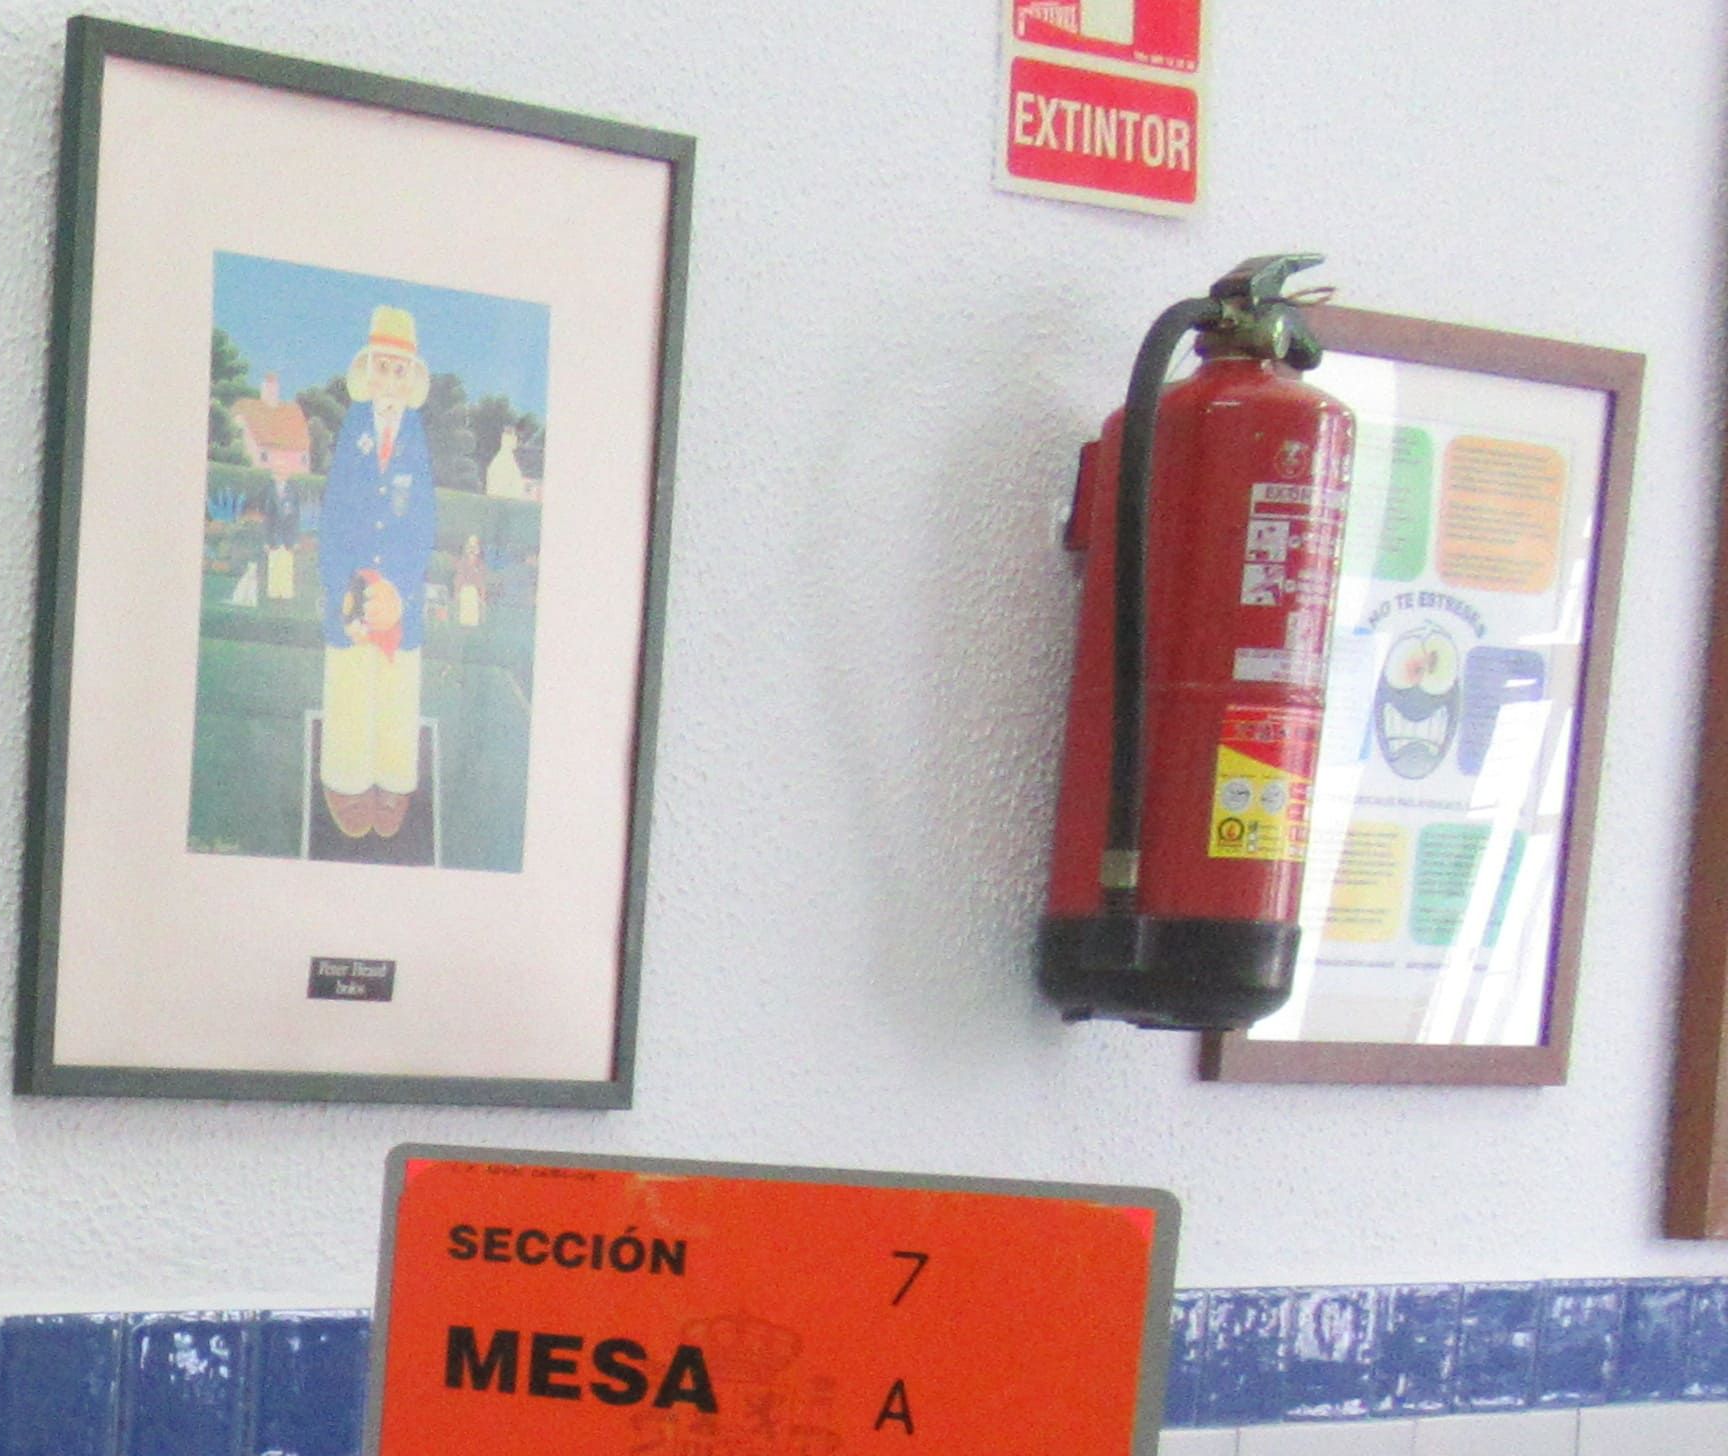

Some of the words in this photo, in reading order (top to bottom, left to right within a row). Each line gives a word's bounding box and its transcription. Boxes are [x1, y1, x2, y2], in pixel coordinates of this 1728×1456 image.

[1013, 91, 1191, 172] EXTINTOR
[447, 1223, 688, 1277] SECCIÓN
[891, 1250, 930, 1307] 7
[444, 1324, 720, 1415] MESA
[873, 1378, 915, 1436] A
